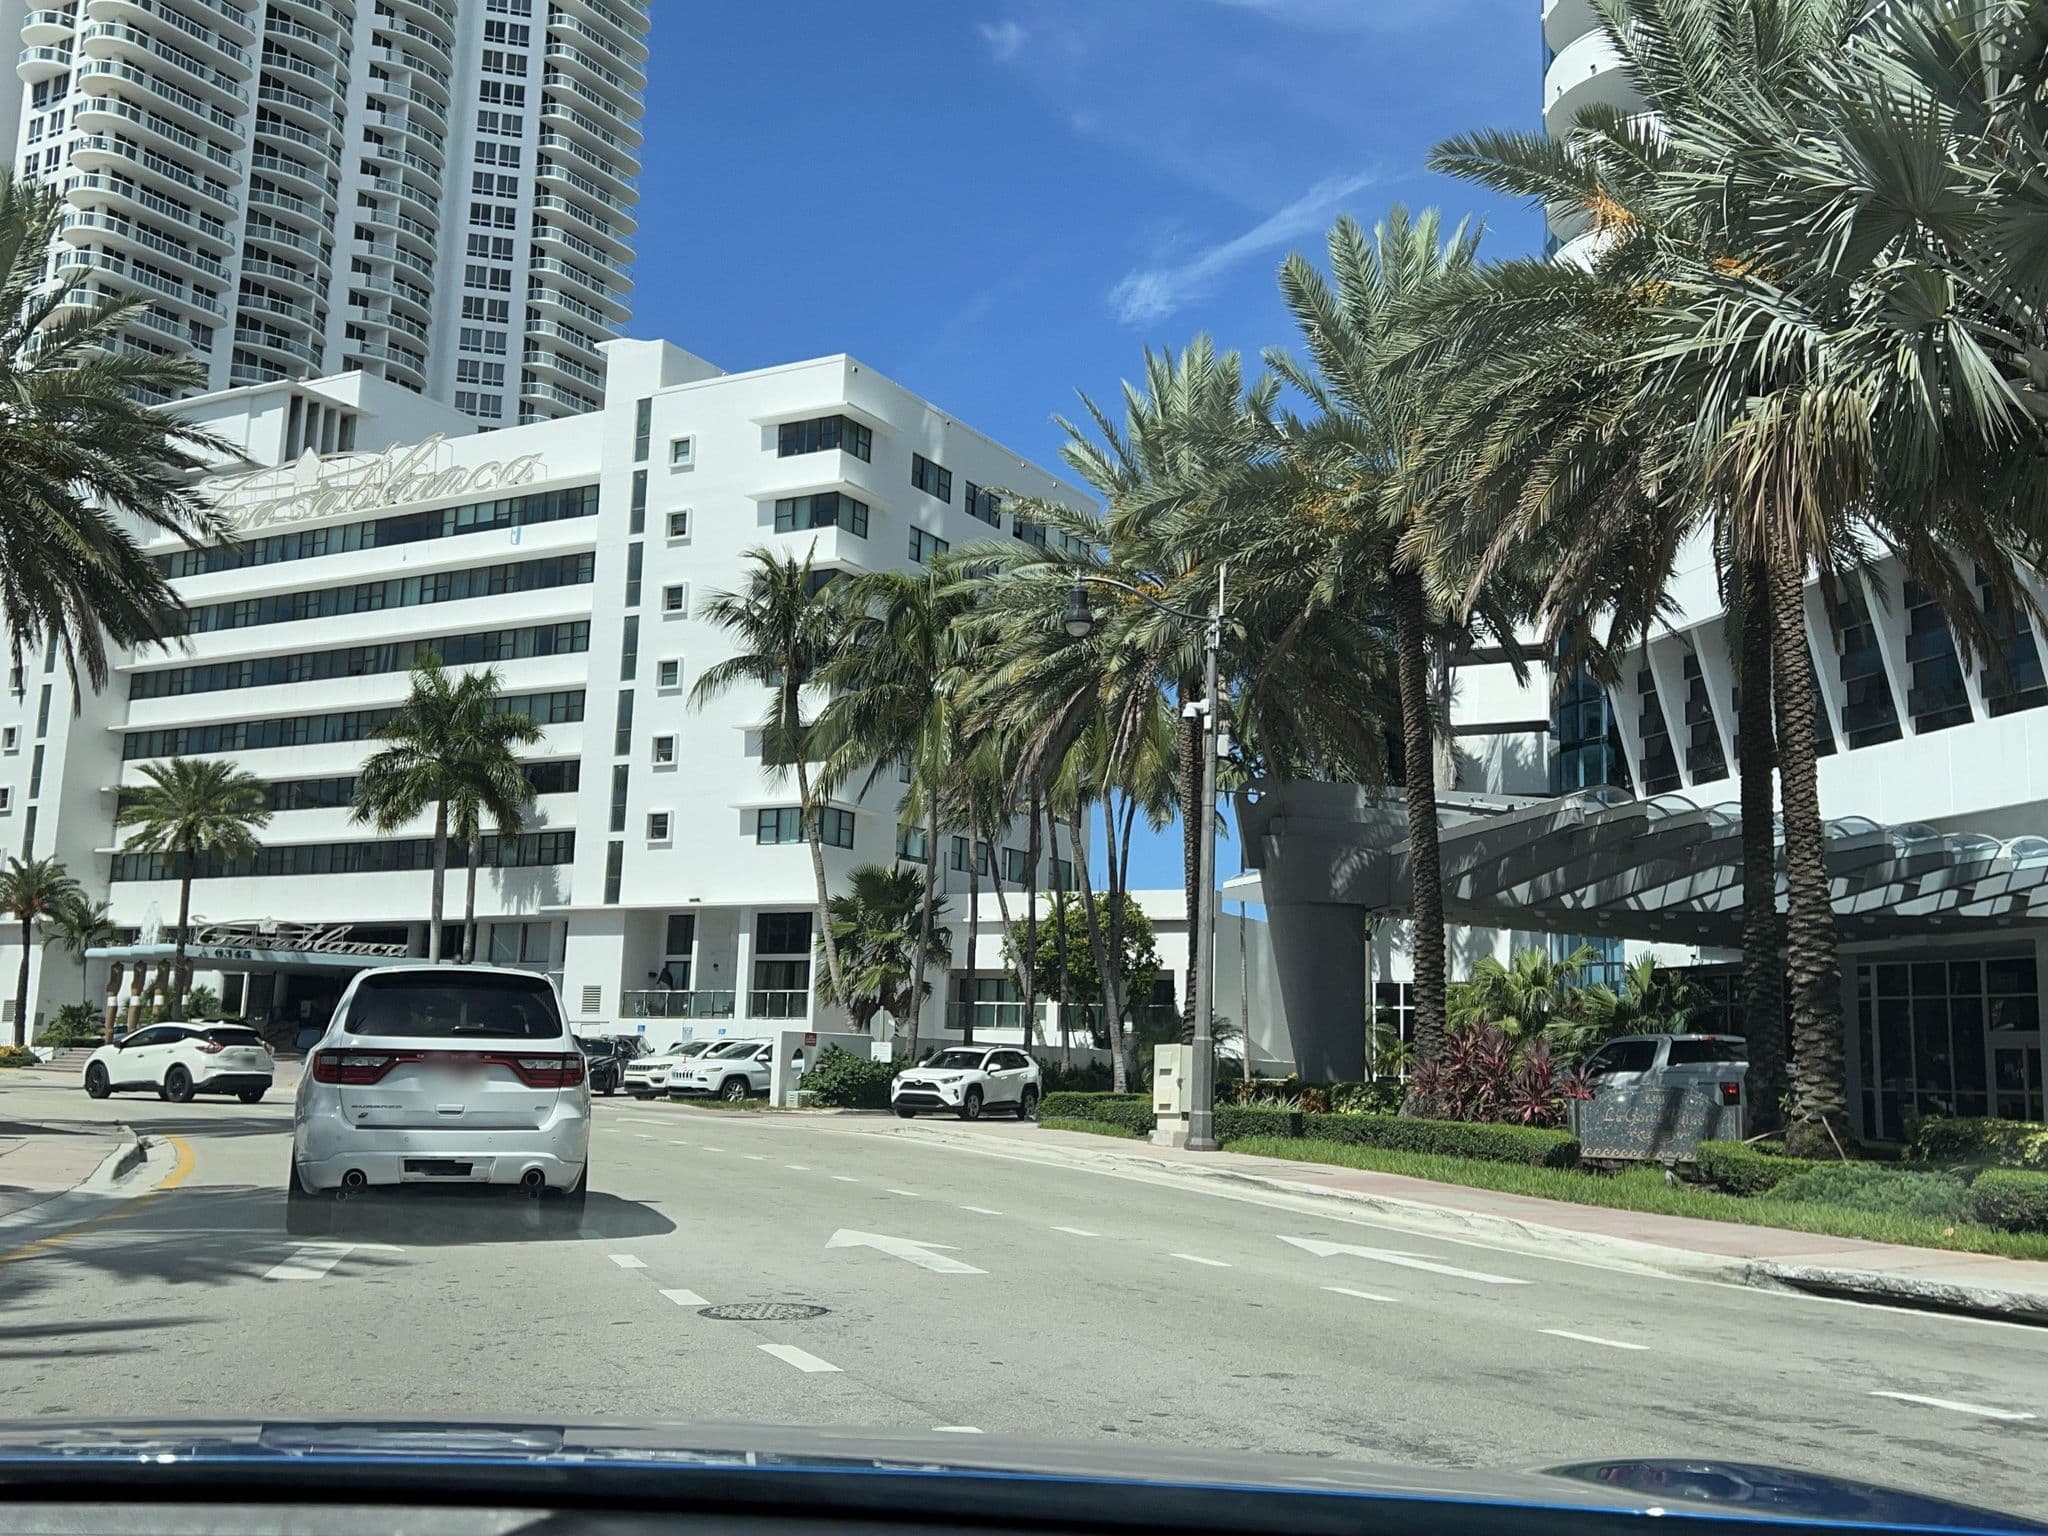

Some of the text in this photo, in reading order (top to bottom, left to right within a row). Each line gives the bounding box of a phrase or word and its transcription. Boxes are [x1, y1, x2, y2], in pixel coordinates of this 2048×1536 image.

[199, 432, 543, 530] Casablanca
[191, 915, 408, 958] Casablanca
[214, 948, 253, 959] 6345
